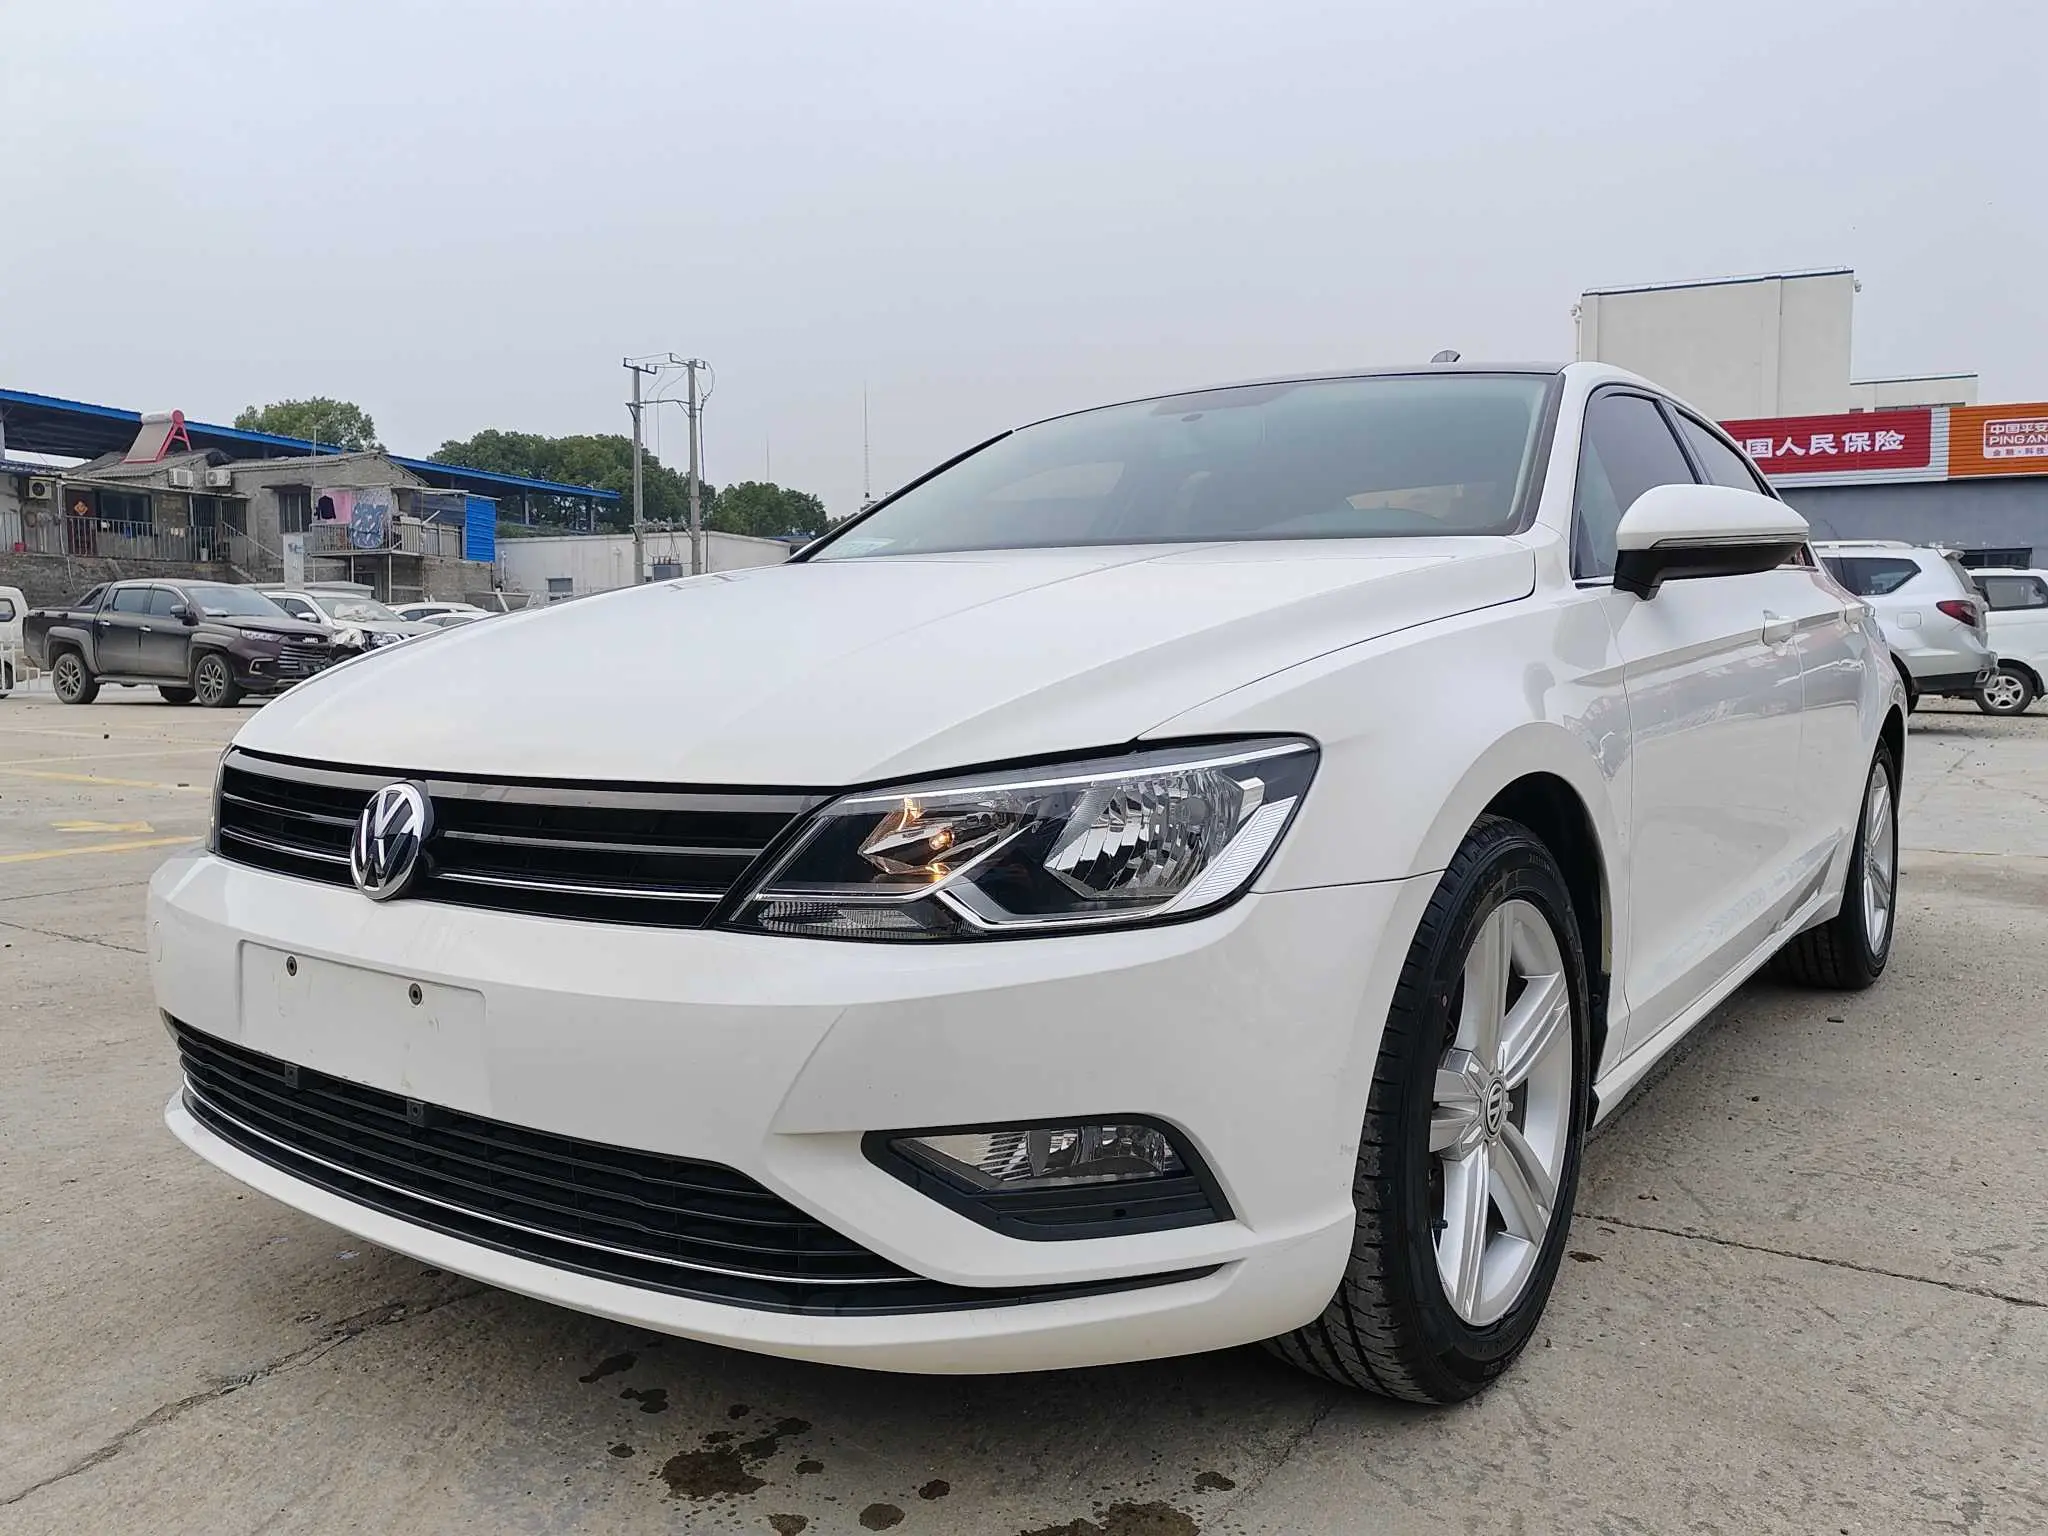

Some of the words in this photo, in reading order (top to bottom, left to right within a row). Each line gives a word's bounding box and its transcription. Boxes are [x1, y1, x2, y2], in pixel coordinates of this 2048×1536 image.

[1991, 423, 2048, 434] 中国平安
[1737, 430, 1905, 458] 国人民保险
